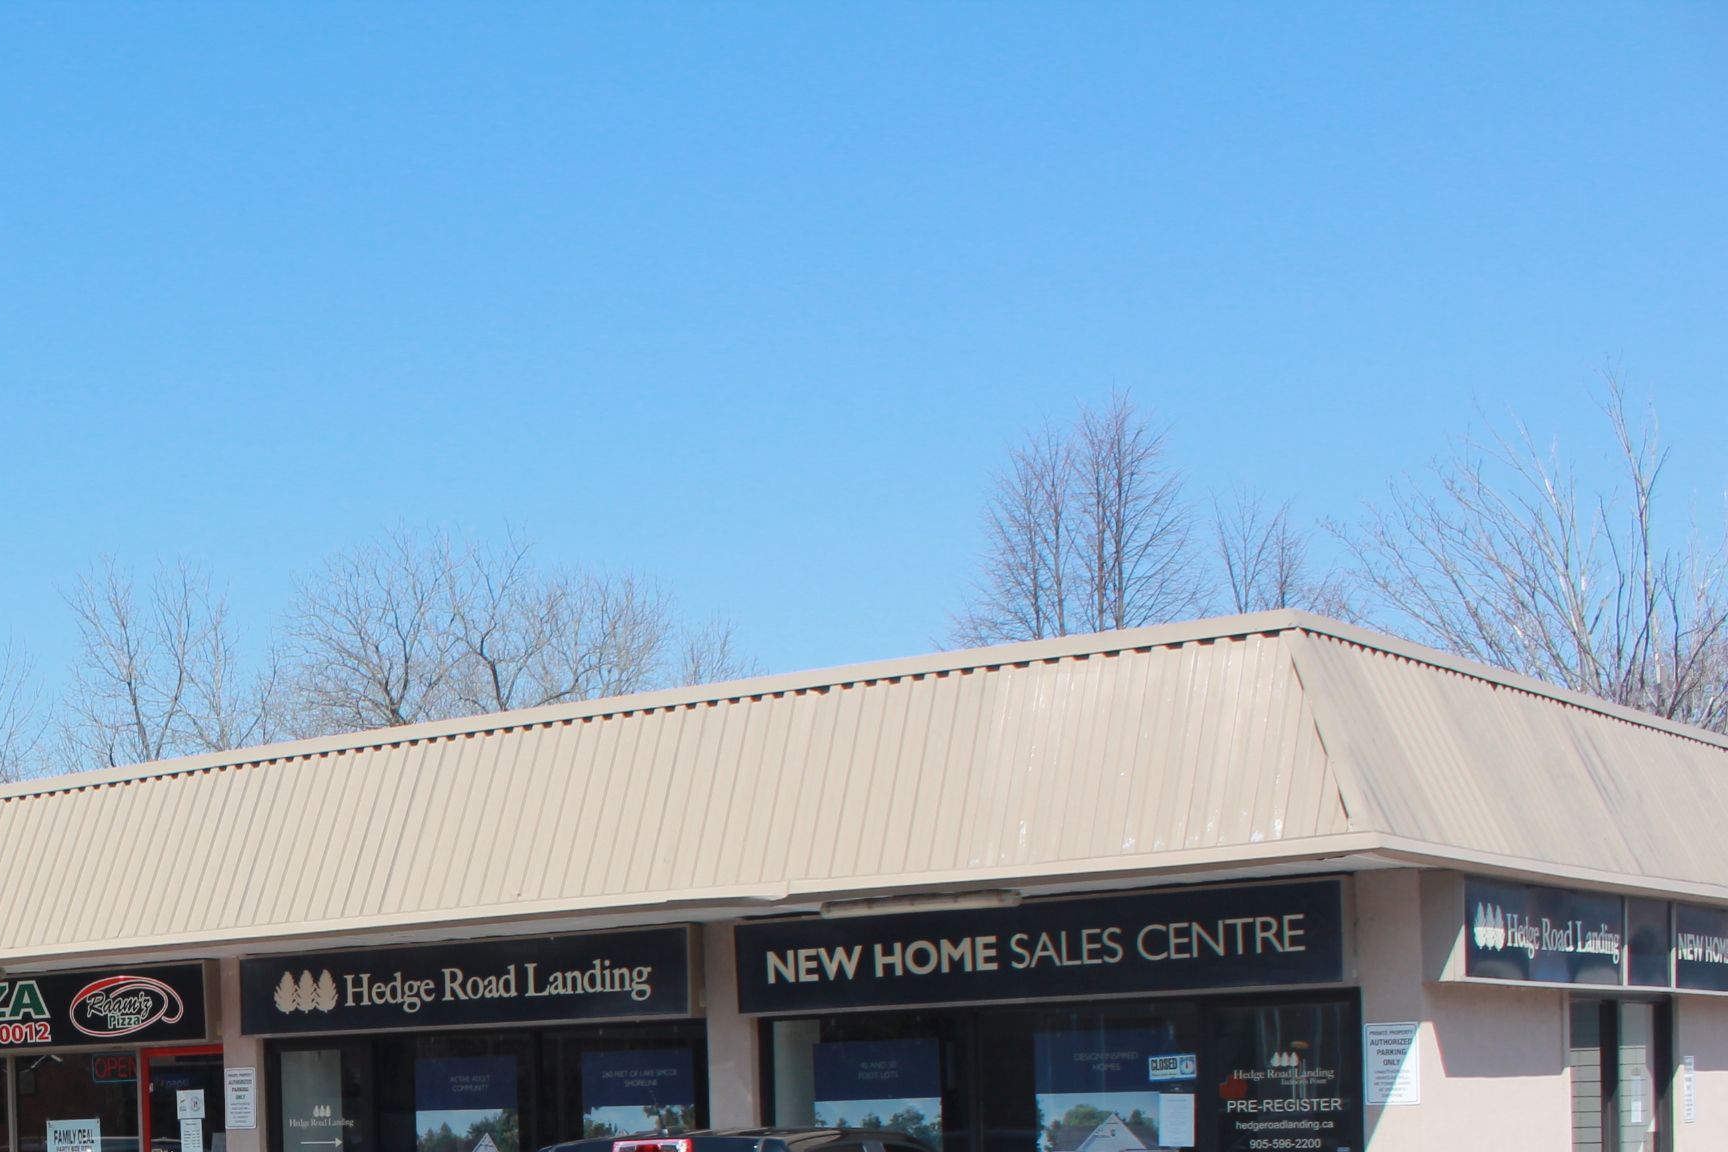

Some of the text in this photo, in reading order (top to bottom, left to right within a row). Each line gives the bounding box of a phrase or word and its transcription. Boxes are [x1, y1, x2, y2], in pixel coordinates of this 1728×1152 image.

[1505, 913, 1620, 964] Hedge Road Landing
[766, 914, 1306, 985] NEW HOME SALES CENTRE
[1678, 933, 1704, 962] NEW
[343, 959, 653, 1013] Hedge Road Landing
[108, 1014, 141, 1029] Pizza
[1370, 1038, 1413, 1046] AUTHORIZED
[1376, 1048, 1407, 1056] PARKING
[1151, 1057, 1178, 1071] CLOSED
[1233, 1068, 1335, 1081] Hedge Road Landing
[1227, 1098, 1342, 1112] PRE-REGISTER
[1235, 1120, 1334, 1131] hedgeroadlanding.ca
[53, 1129, 95, 1144] FAMILY DEAL
[1249, 1138, 1321, 1149] 905-596-2200
